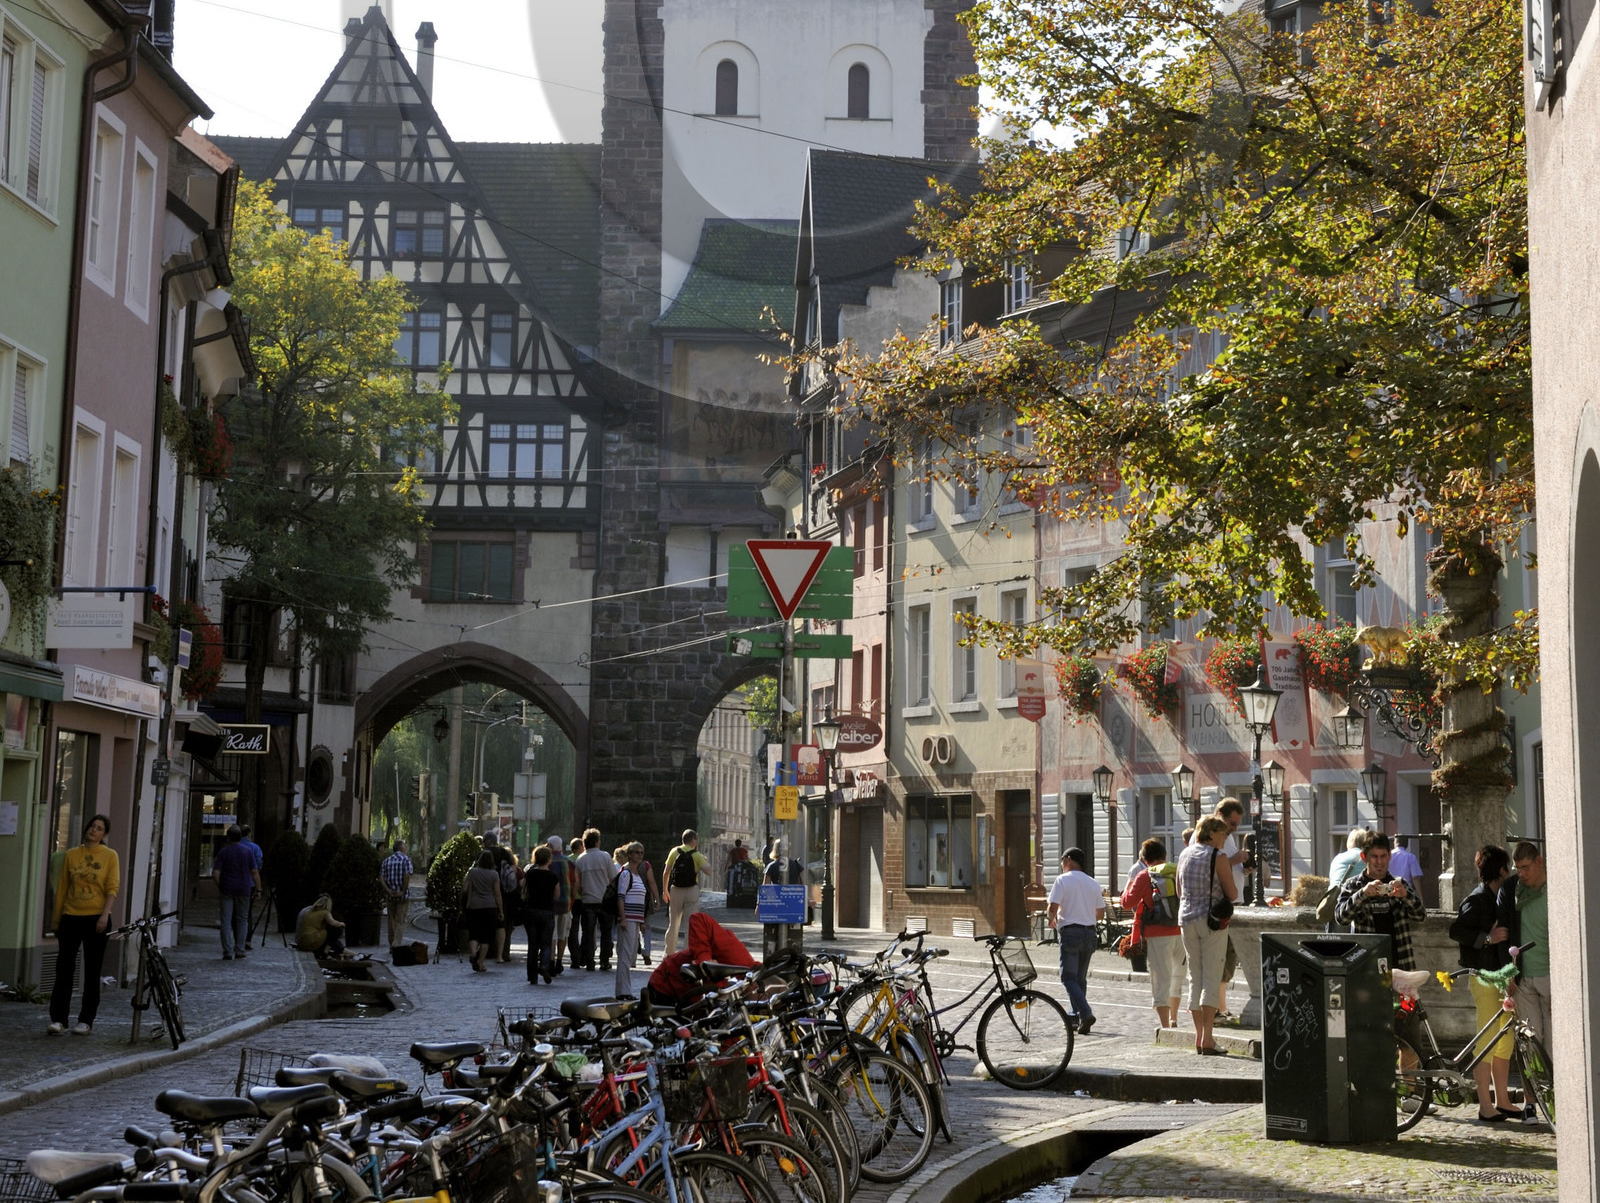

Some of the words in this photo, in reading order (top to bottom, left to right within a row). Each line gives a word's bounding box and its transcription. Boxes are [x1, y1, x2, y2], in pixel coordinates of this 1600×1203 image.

[1272, 674, 1301, 682] Gasthaus
[1274, 683, 1302, 691] Tradition
[226, 733, 263, 751] Rath
[837, 729, 879, 745] teiber
